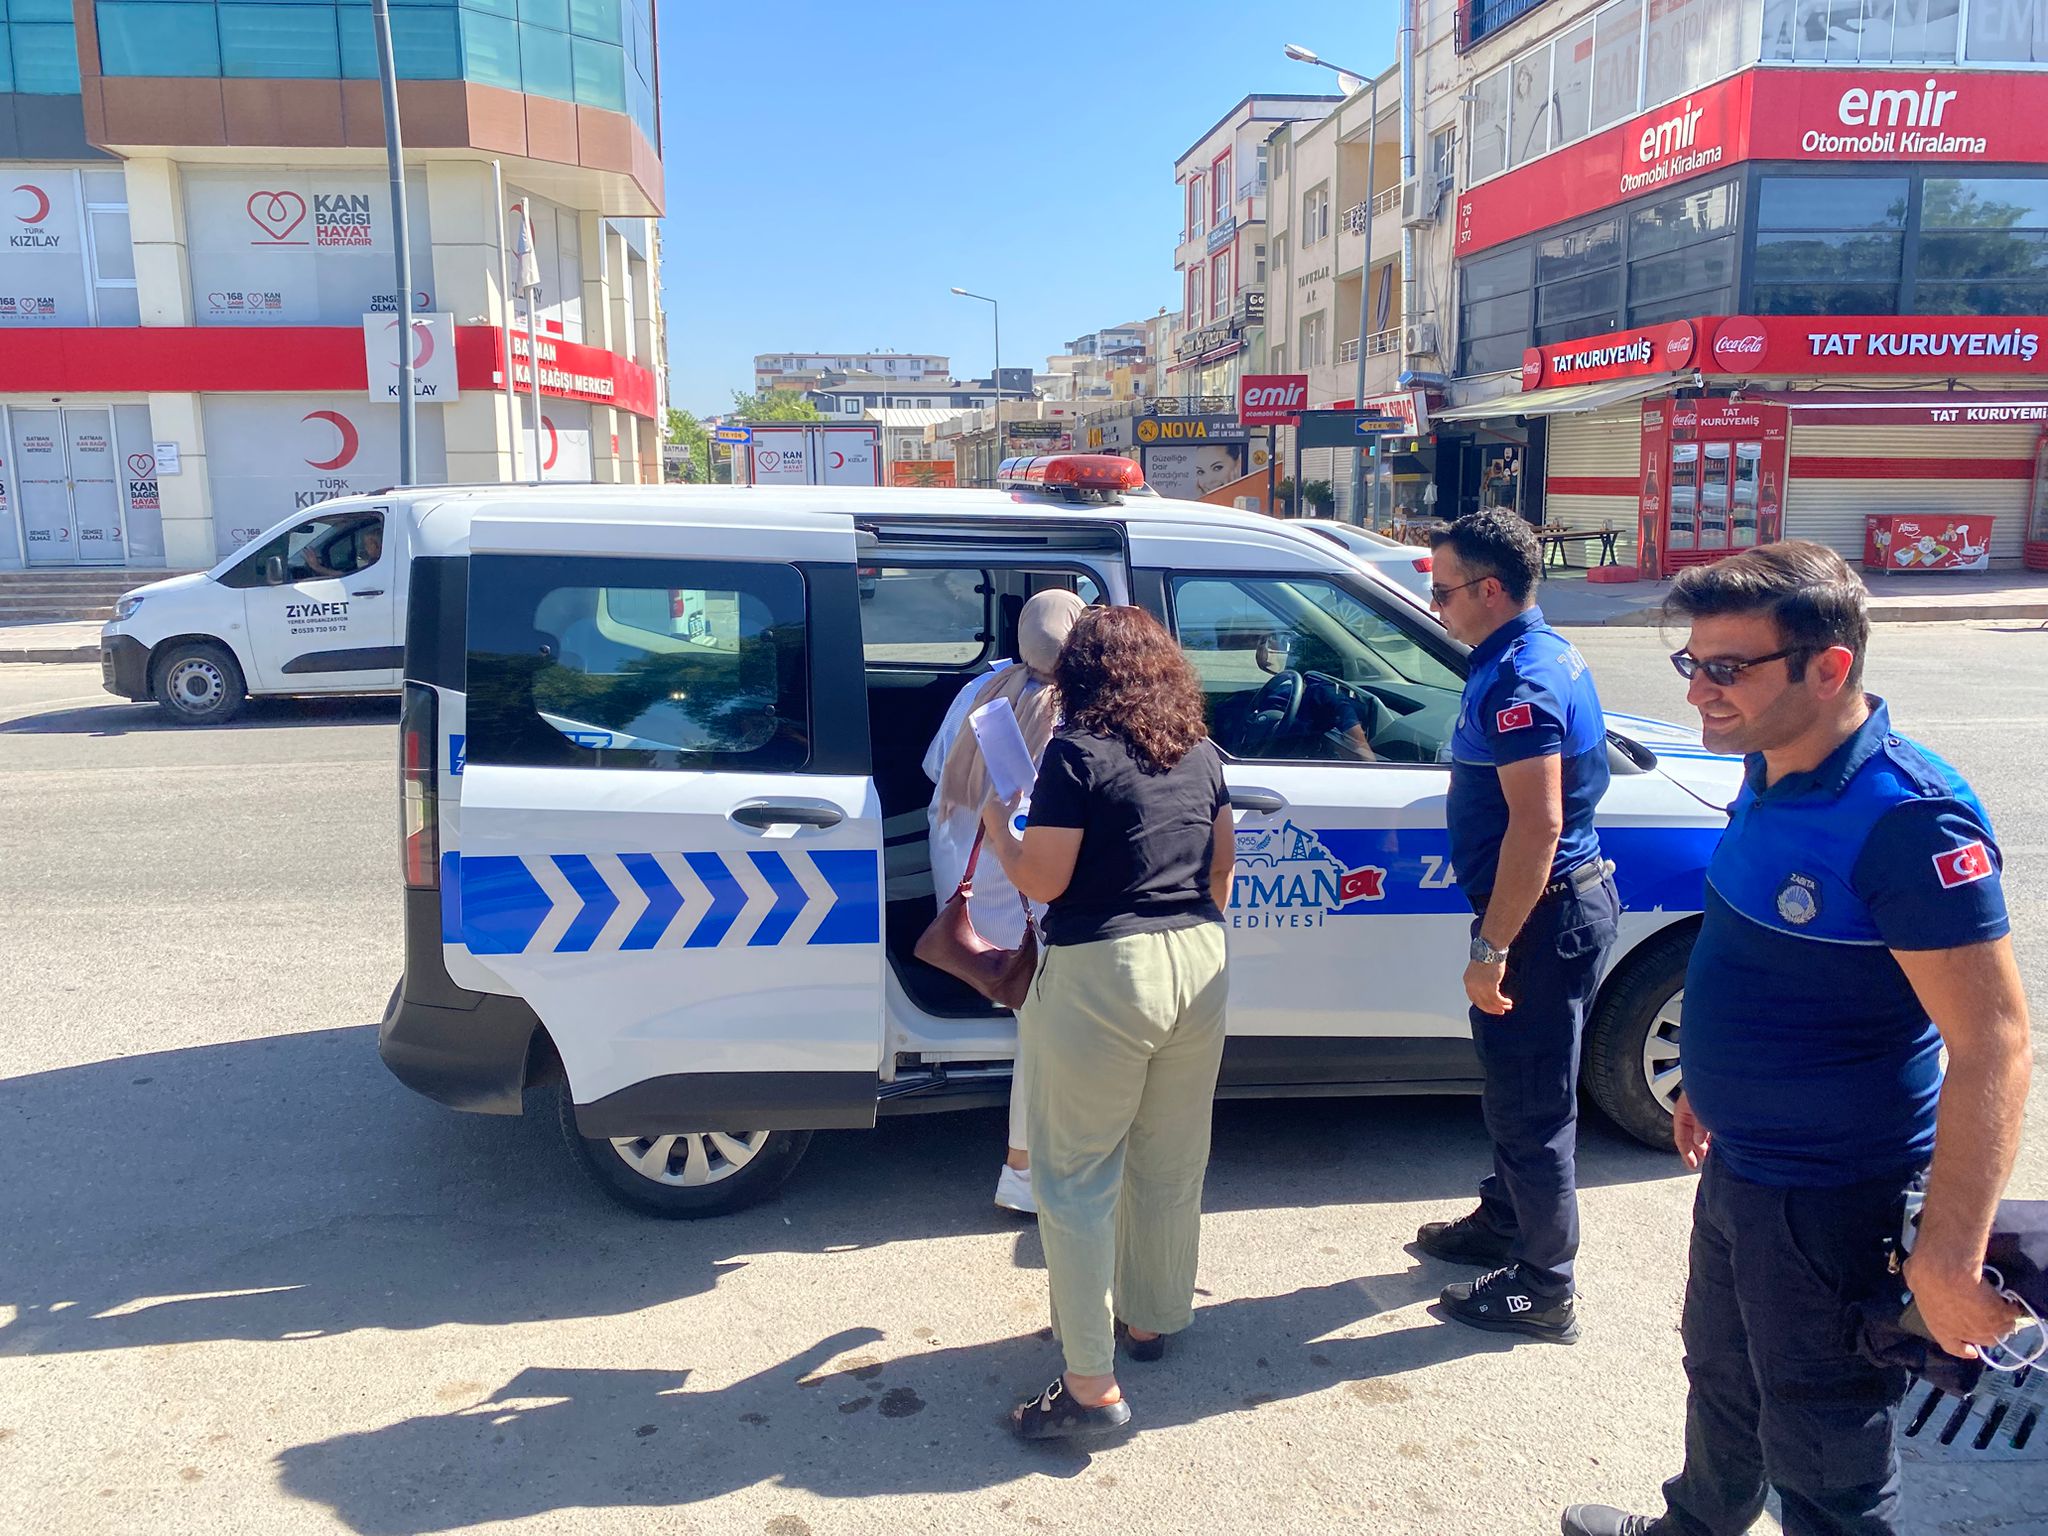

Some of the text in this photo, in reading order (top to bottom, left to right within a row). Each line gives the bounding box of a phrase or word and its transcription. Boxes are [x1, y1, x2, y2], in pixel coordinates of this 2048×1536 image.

[1838, 78, 1957, 127] emir
[1640, 99, 1704, 162] emir
[1802, 130, 1987, 153] Otomobil Kiralama
[1620, 146, 1722, 193] Otomobil Kiralama
[313, 194, 370, 212] KAN
[315, 211, 371, 226] BAĞIŞI
[23, 226, 45, 234] TÜRK
[316, 225, 371, 238] HAYAT
[9, 235, 60, 247] KIZILAY
[317, 237, 372, 247] KURTARIR
[227, 292, 243, 300] 168
[371, 294, 398, 304] SENSİ
[370, 303, 398, 312] OLMA
[513, 336, 557, 362] BAMAN
[1666, 336, 1691, 354] Coca-Cola
[1715, 335, 1767, 354] Coca-Cola
[1808, 328, 2039, 361] TAT KURUYEMİŞ
[1552, 337, 1652, 373] TAT KURUYEMİŞ
[540, 367, 573, 392] BAĞIŞI
[575, 375, 614, 397] MERKEZİ
[1244, 383, 1305, 406] emir
[1672, 413, 1698, 426] Coca-Cola
[1721, 408, 1740, 417] TAT
[1931, 410, 1959, 421] TAT
[1701, 415, 1760, 427] KURUYEMİŞ
[1161, 421, 1207, 439] NOVA
[783, 451, 803, 459] KAN
[130, 481, 158, 491] KAN
[317, 477, 349, 488] TÜRK
[1237, 836, 1257, 846] 1955
[1229, 869, 1345, 909] TMAN
[1233, 911, 1324, 929] EDİYESİ
[1506, 1295, 1532, 1313] DG
